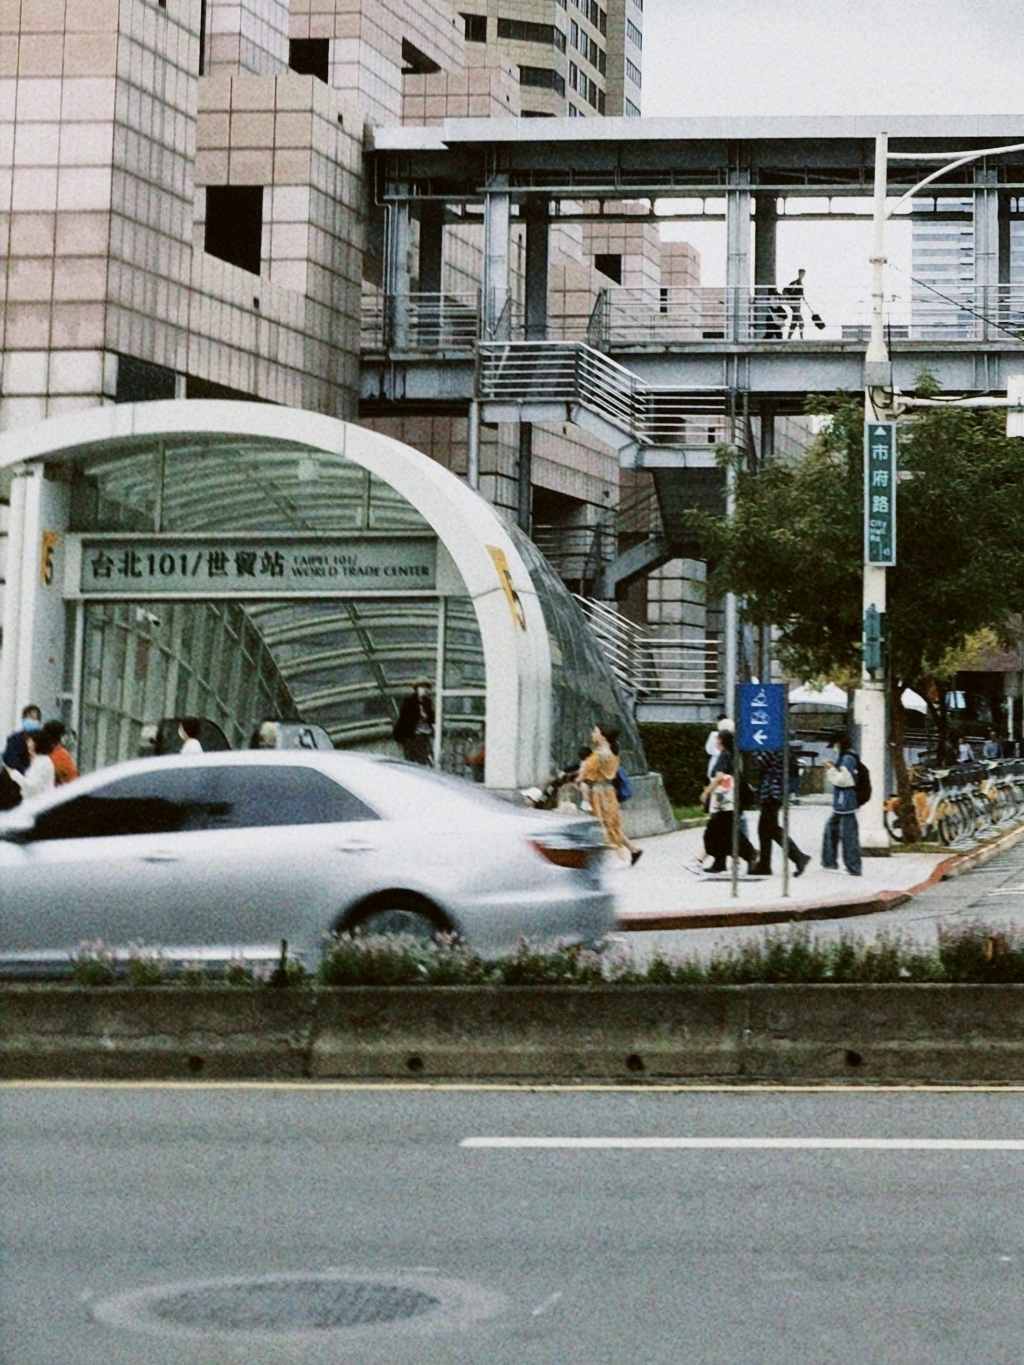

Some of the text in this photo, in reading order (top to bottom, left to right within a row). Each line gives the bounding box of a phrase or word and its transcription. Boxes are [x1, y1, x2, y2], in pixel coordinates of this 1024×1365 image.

[871, 443, 889, 513] 市府路
[91, 549, 285, 578] 台北101/世貿站
[291, 565, 430, 577] WORLD TRADE CENTER
[293, 555, 329, 566] TAIPEI
[503, 569, 526, 632] 5
